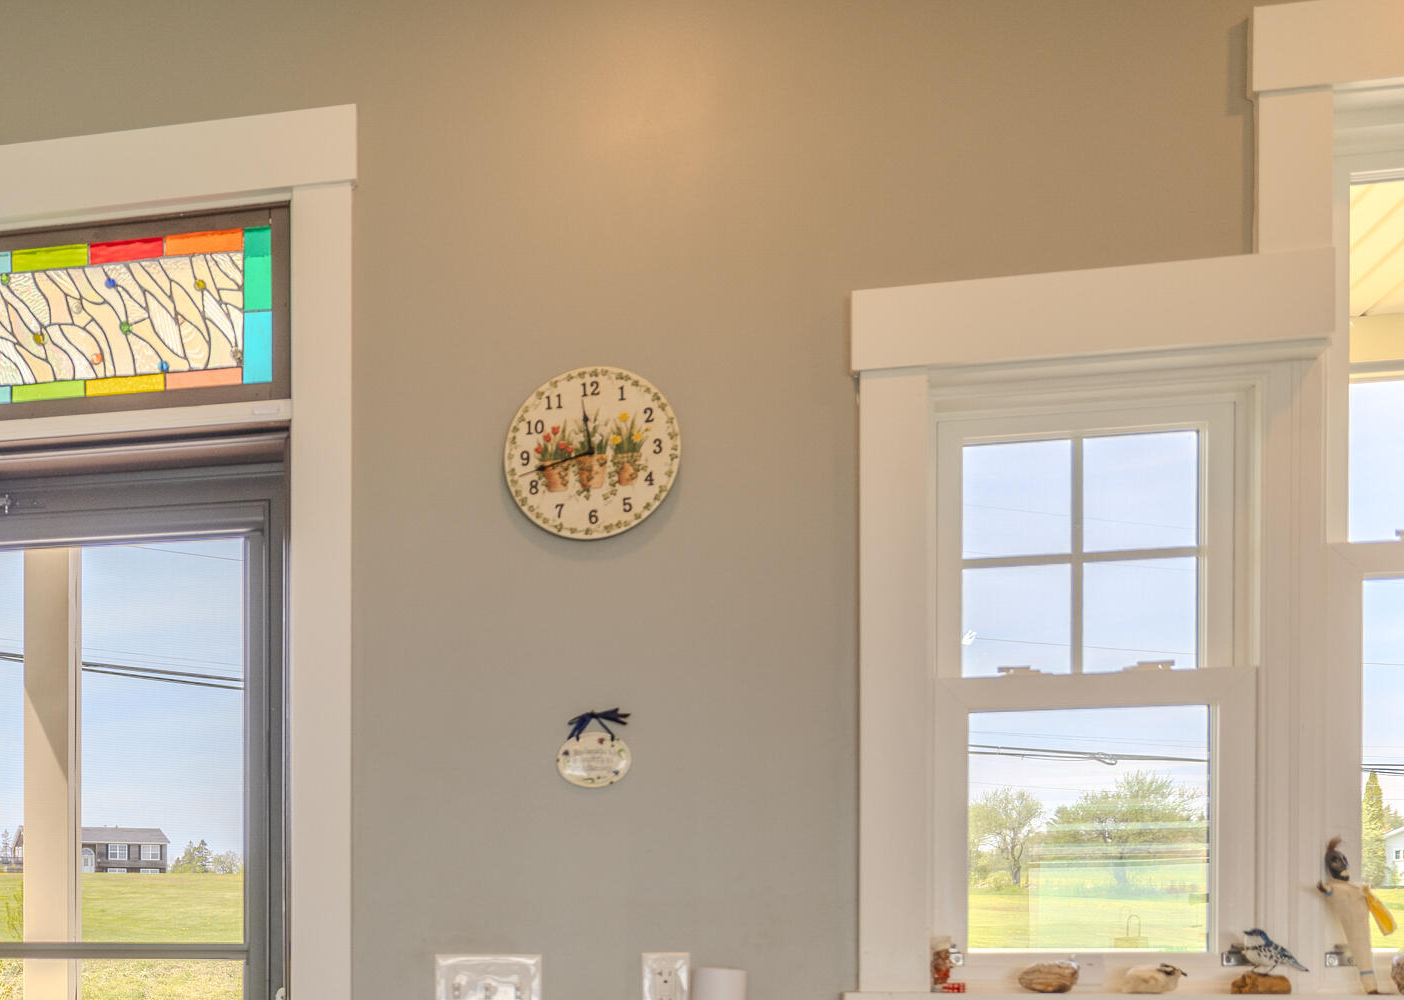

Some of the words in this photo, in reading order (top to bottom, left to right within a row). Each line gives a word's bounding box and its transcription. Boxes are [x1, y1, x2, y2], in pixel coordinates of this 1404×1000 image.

[581, 380, 601, 397] 12
[618, 385, 626, 401] 1
[545, 394, 563, 410] 11
[643, 407, 654, 423] 2
[525, 419, 545, 435] 10
[653, 438, 663, 454] 3
[520, 450, 530, 466] 9
[644, 471, 654, 486] 4
[529, 479, 539, 495] 8
[554, 503, 564, 519] 7
[622, 497, 633, 513] 5
[588, 509, 598, 524] 6
